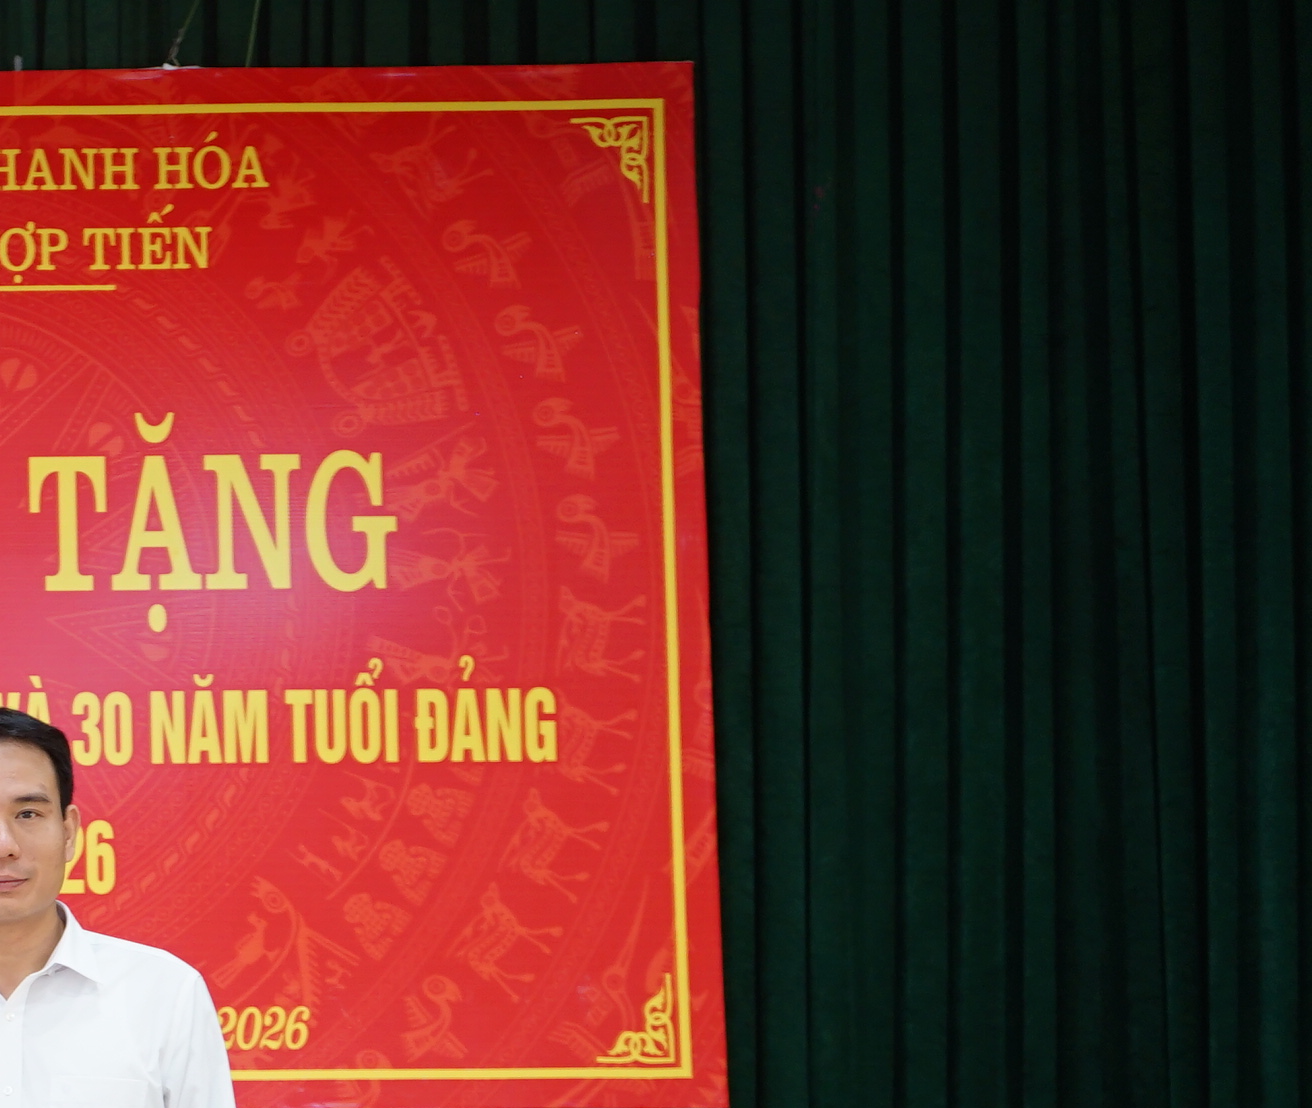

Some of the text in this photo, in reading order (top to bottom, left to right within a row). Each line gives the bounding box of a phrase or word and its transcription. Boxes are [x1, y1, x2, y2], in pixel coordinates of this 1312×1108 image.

[153, 131, 268, 190] HÓA
[83, 203, 211, 271] TIẾN
[29, 411, 397, 632] TẶNG
[72, 691, 133, 766] 30
[150, 674, 268, 764] NĂM
[284, 658, 398, 765] TUỔI
[414, 655, 557, 763] ĐẢNG
[218, 1005, 311, 1051] 2026
